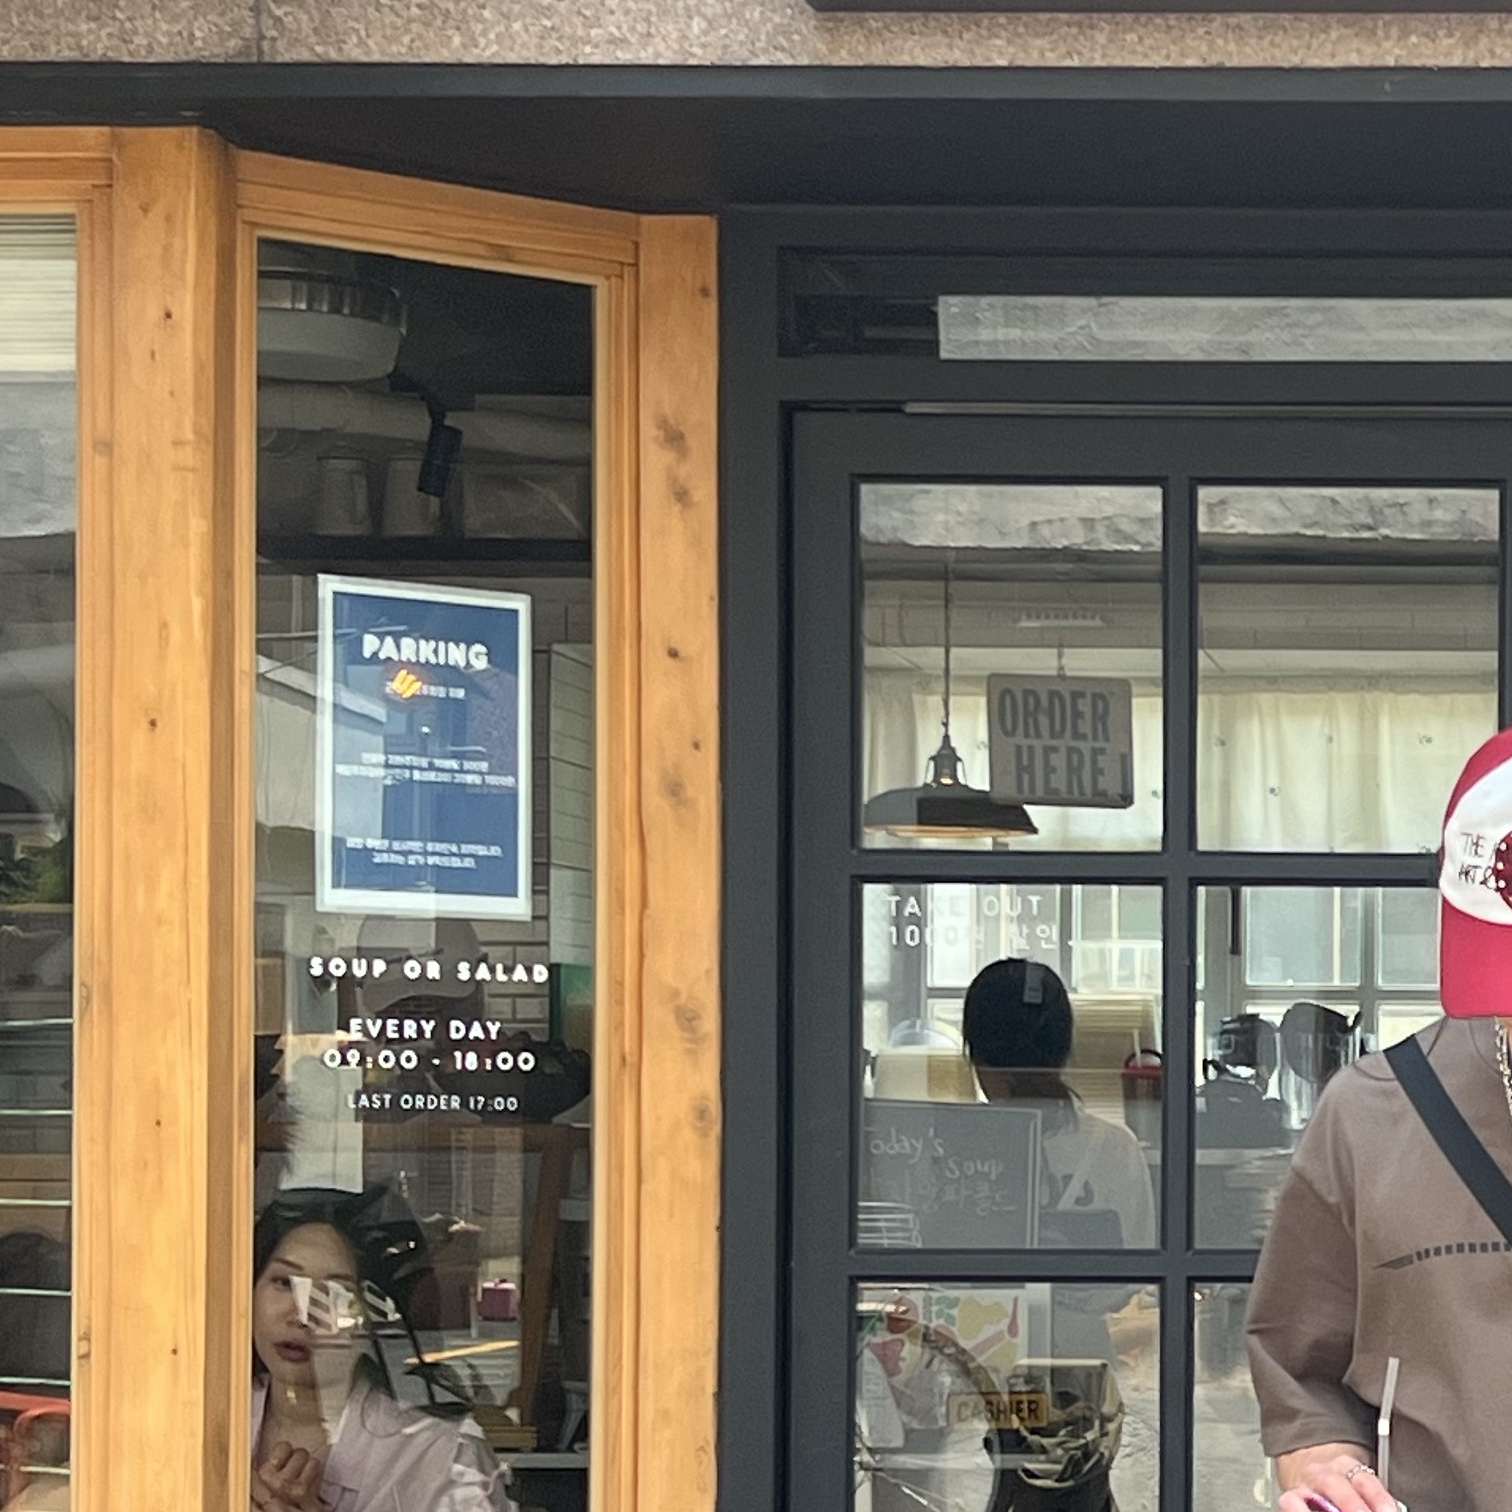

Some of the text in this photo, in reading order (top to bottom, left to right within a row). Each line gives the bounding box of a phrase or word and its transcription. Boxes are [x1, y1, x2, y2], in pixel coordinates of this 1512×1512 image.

[362, 634, 489, 669] PARKING
[999, 687, 1110, 743] ORDER
[1015, 744, 1109, 797] HERE
[1460, 831, 1487, 858] THE
[982, 894, 1043, 917] OUT
[308, 956, 550, 983] SOUP OR SALAD
[349, 1018, 502, 1041] EVERY DAY
[322, 1049, 419, 1070] 09:00
[453, 1050, 537, 1071] 18:00
[346, 1093, 519, 1112] LAST ORDER 17:00
[864, 1126, 946, 1164] oday's
[945, 1155, 1003, 1181] Soup
